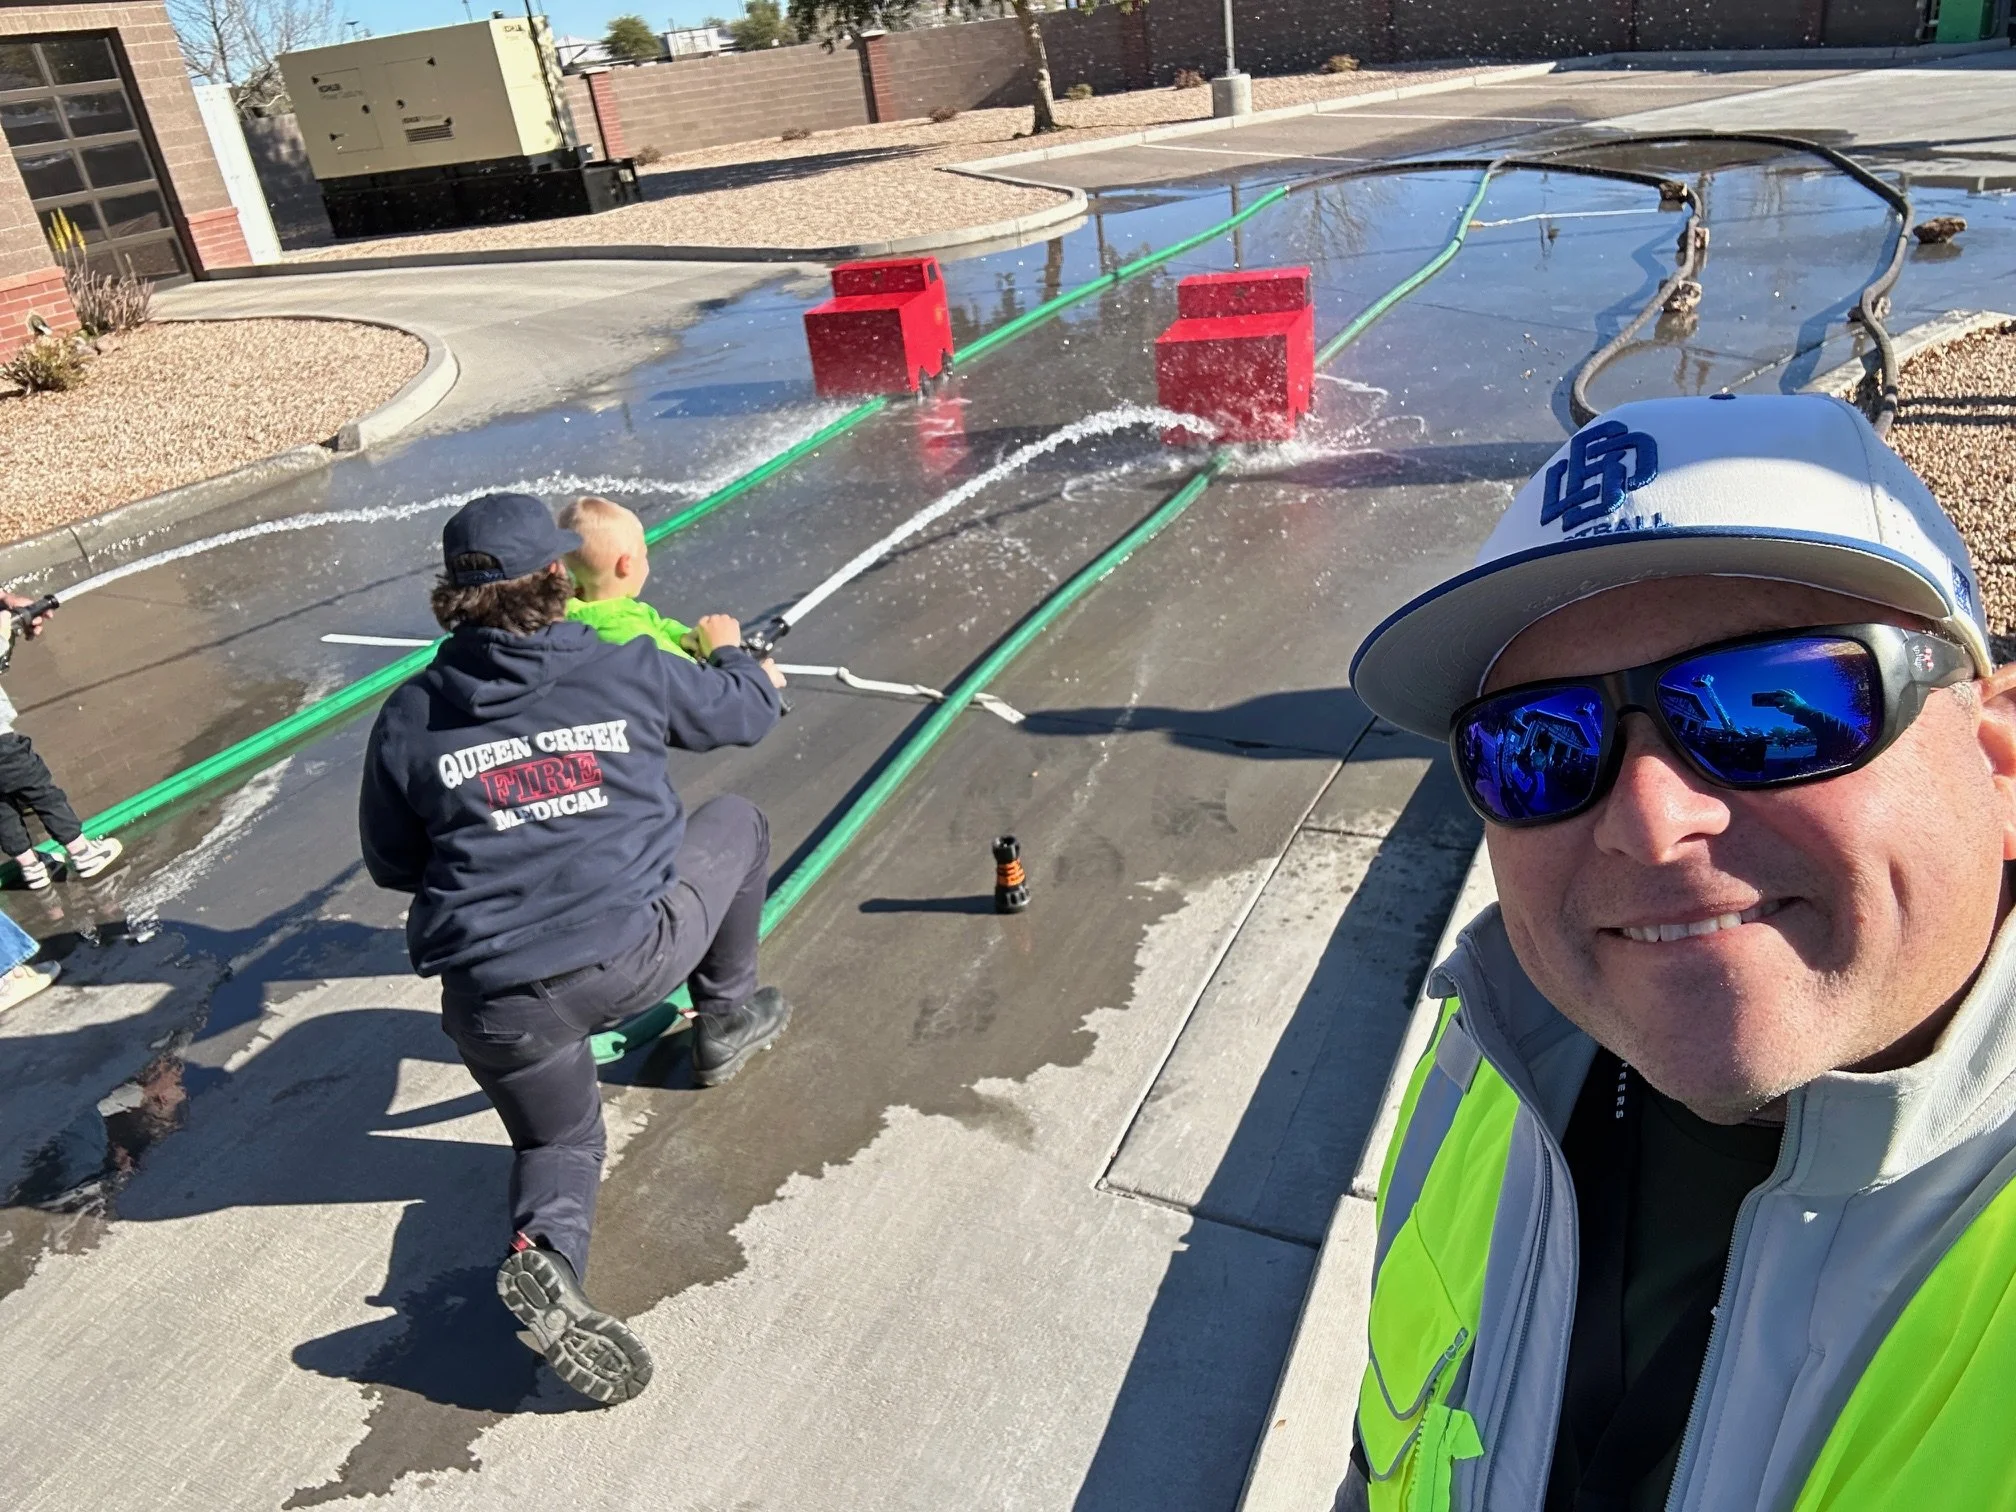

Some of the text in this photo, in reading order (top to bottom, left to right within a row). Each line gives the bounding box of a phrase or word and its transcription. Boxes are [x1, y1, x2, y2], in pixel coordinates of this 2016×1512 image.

[438, 719, 631, 790] QUEEN CREEK
[480, 751, 604, 809] FIRE
[489, 787, 609, 832] MEDICAL
